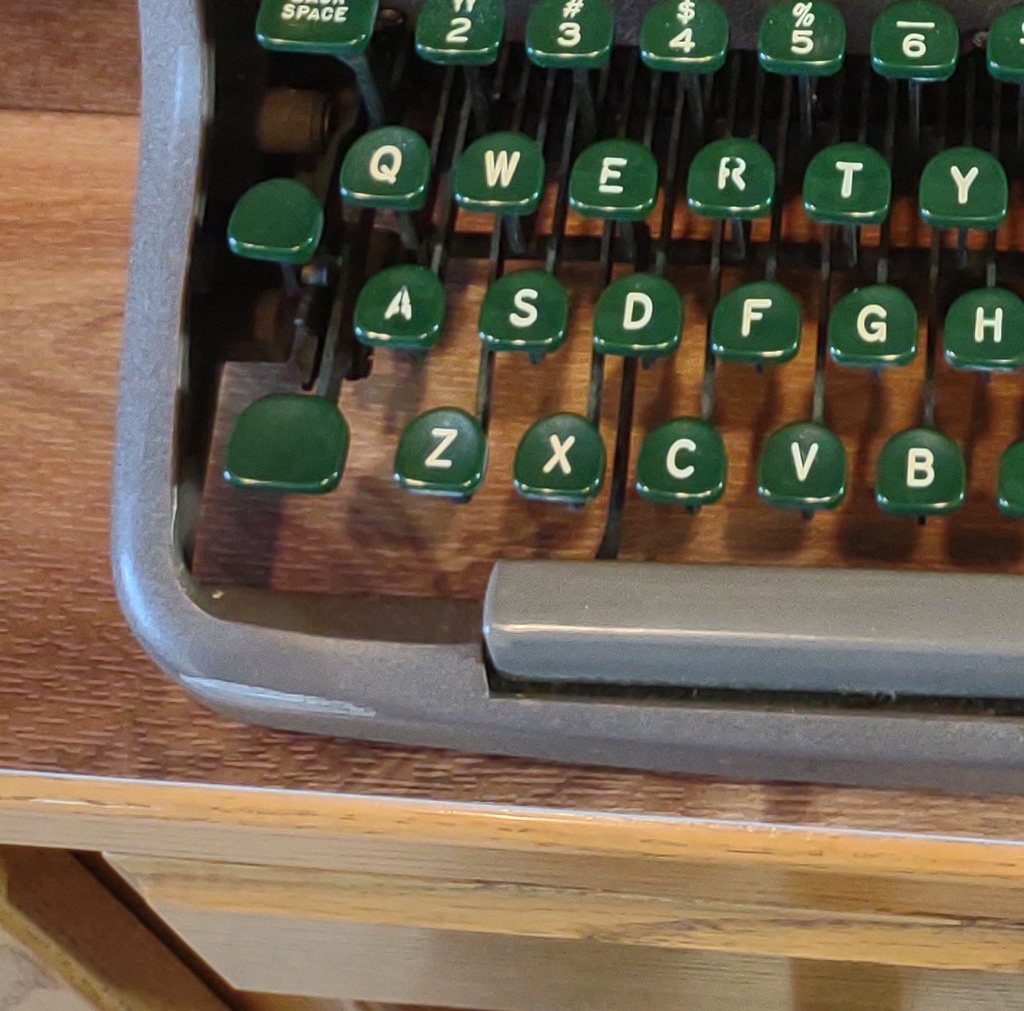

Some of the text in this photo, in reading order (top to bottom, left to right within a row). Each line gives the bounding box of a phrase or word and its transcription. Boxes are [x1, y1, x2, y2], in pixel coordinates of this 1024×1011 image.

[280, 2, 349, 23] SPACE
[445, 17, 472, 43] 2
[792, 1, 815, 28] %
[557, 21, 582, 47] 3
[668, 27, 696, 54] 4
[790, 29, 814, 55] 5
[902, 32, 927, 58] 6
[368, 144, 403, 184] Q
[484, 149, 521, 188] W
[598, 156, 628, 194] E
[717, 156, 747, 191] R
[835, 161, 864, 199] T
[950, 165, 979, 205] Y
[384, 287, 412, 321] A
[508, 288, 539, 328] S
[622, 291, 653, 331] D
[741, 298, 773, 337] F
[856, 304, 887, 343] G
[974, 306, 1003, 343] H
[424, 427, 459, 468] Z
[542, 434, 576, 475] X
[666, 438, 697, 480] C
[790, 441, 819, 482] V
[906, 447, 935, 488] B
